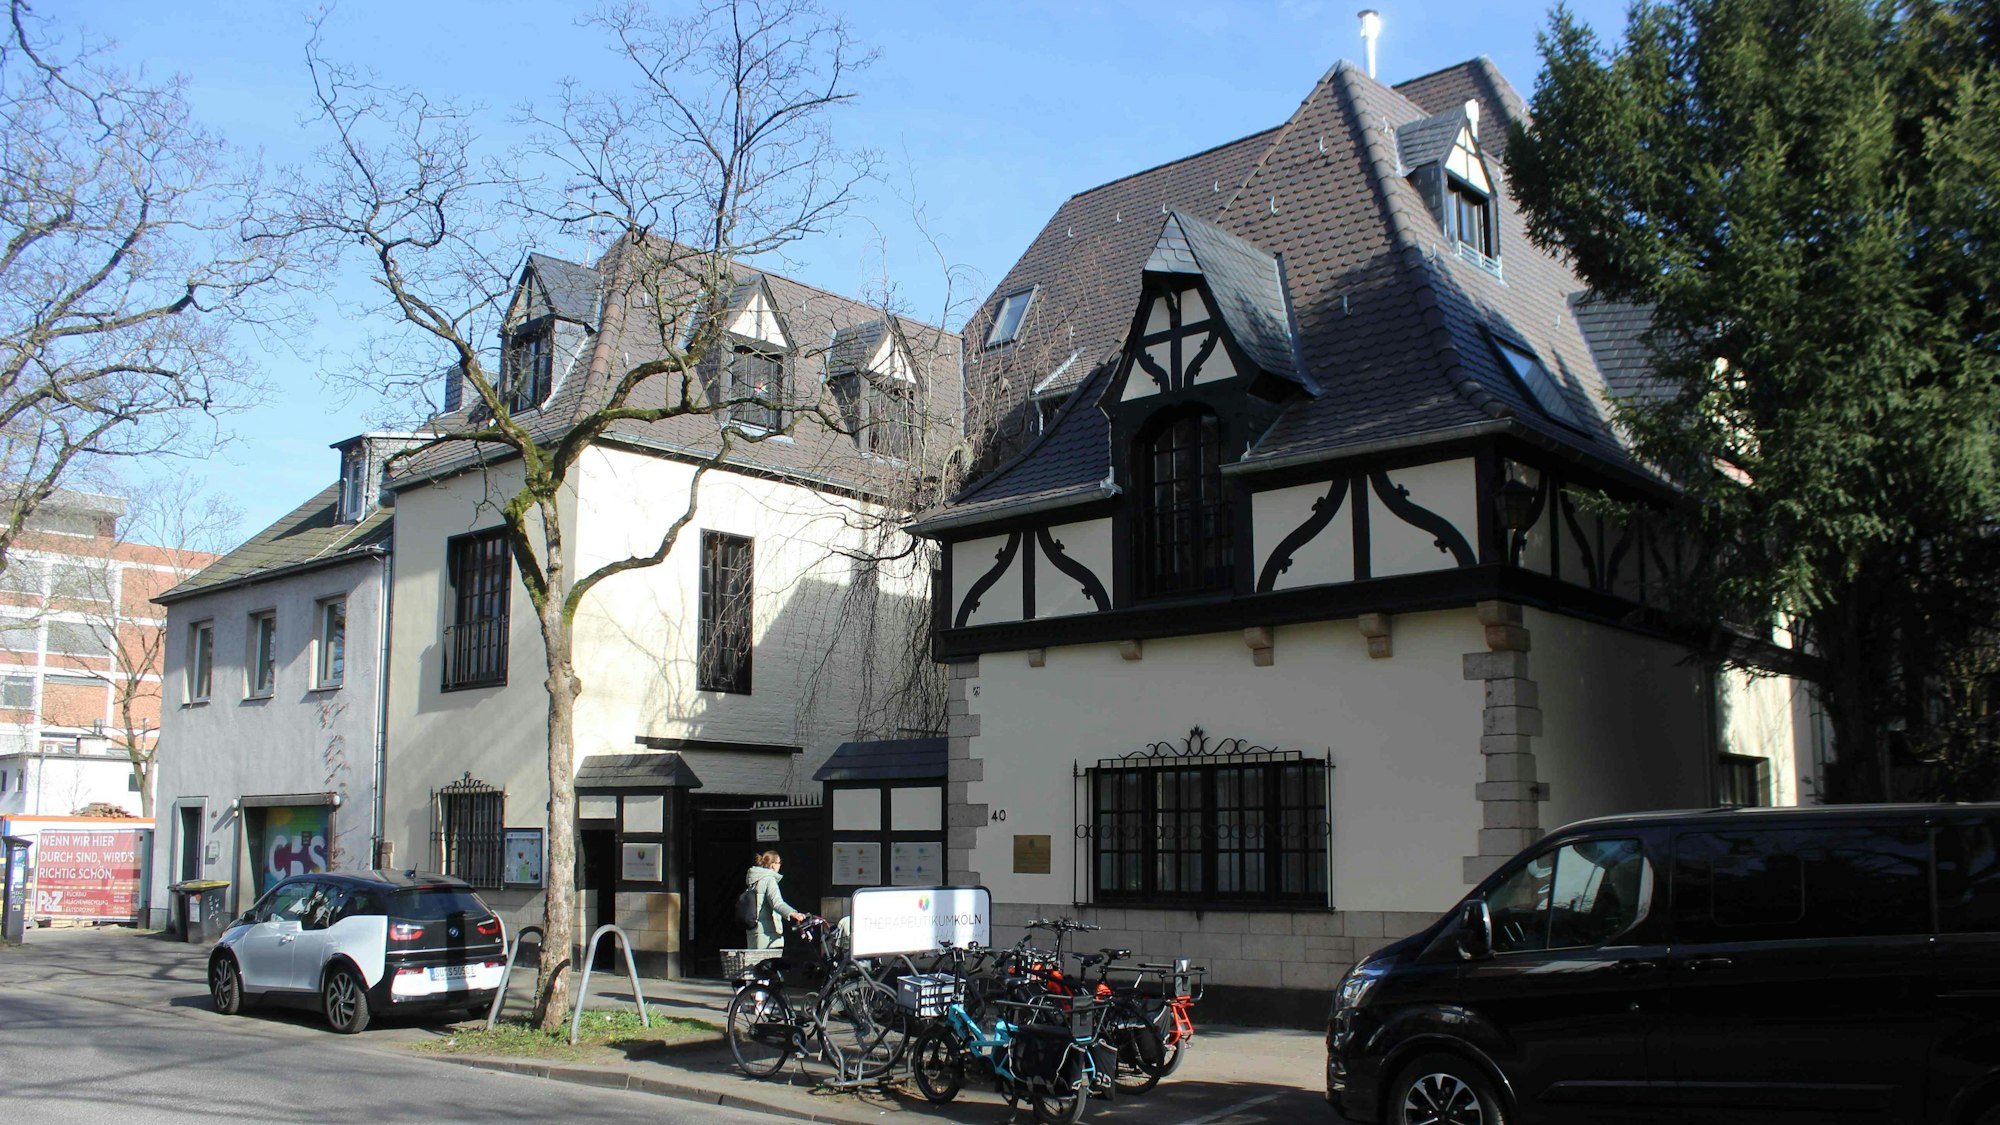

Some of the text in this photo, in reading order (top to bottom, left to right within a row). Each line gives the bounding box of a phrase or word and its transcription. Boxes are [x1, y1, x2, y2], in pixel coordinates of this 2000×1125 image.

[991, 809, 1006, 821] 40
[41, 835, 115, 846] WENN WIR HIER
[40, 851, 135, 865] DURCH SIND, WIRD'S
[39, 866, 115, 879] RICHTIG SCHÖN.
[37, 890, 64, 912] P&Z
